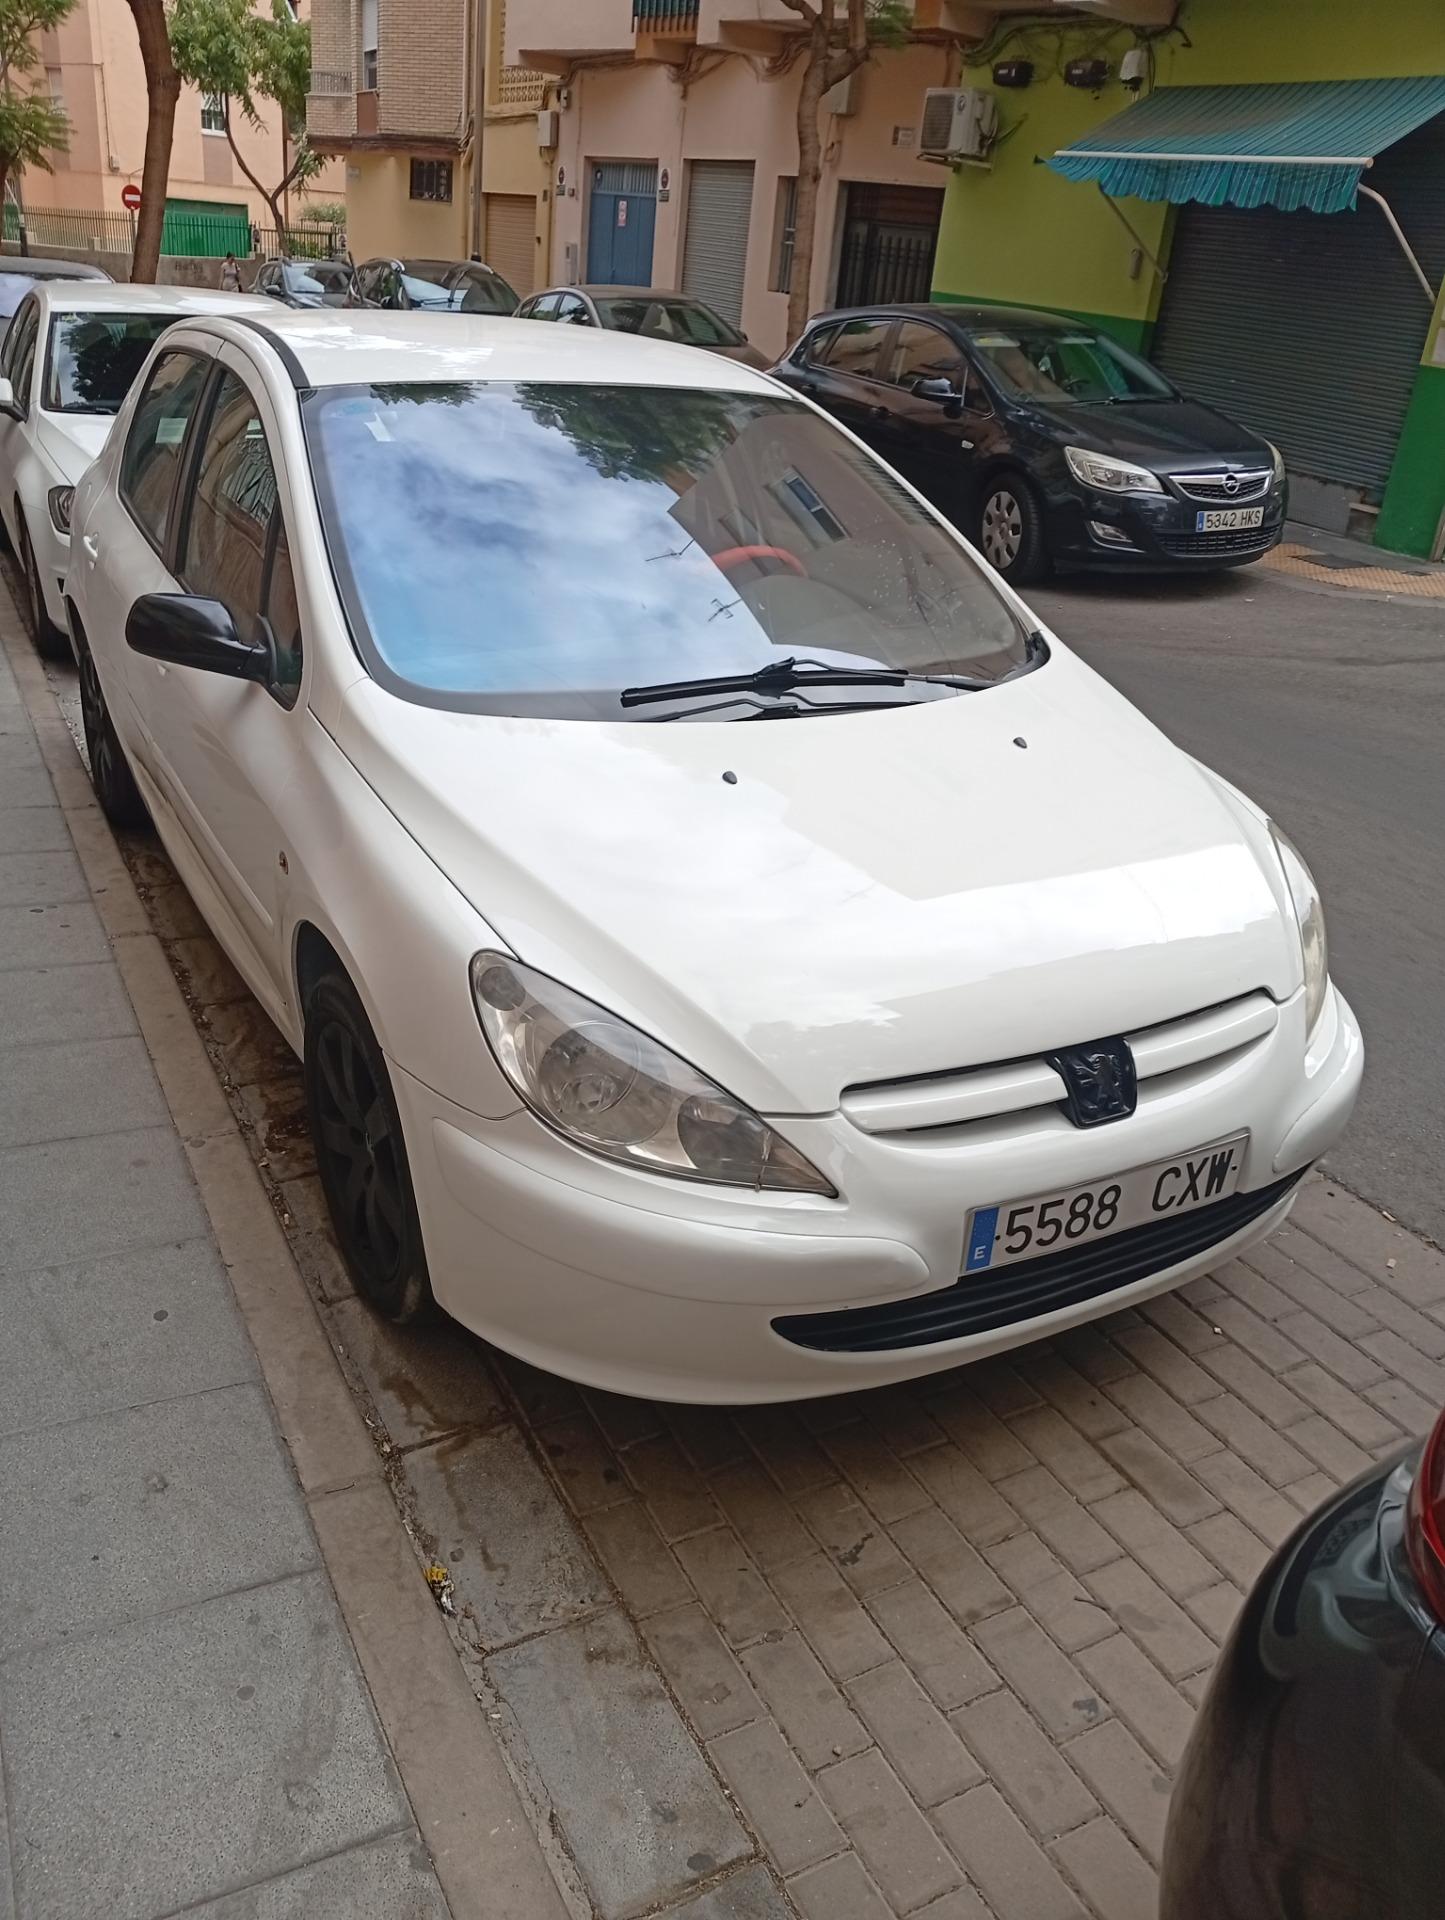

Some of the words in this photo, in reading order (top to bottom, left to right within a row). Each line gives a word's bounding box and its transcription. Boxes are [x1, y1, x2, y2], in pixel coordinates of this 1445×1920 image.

[1206, 512, 1237, 528] 5342
[1240, 510, 1261, 526] HKS
[1005, 1184, 1122, 1254] 5588
[1151, 1149, 1234, 1212] CXW
[974, 1245, 986, 1260] E
